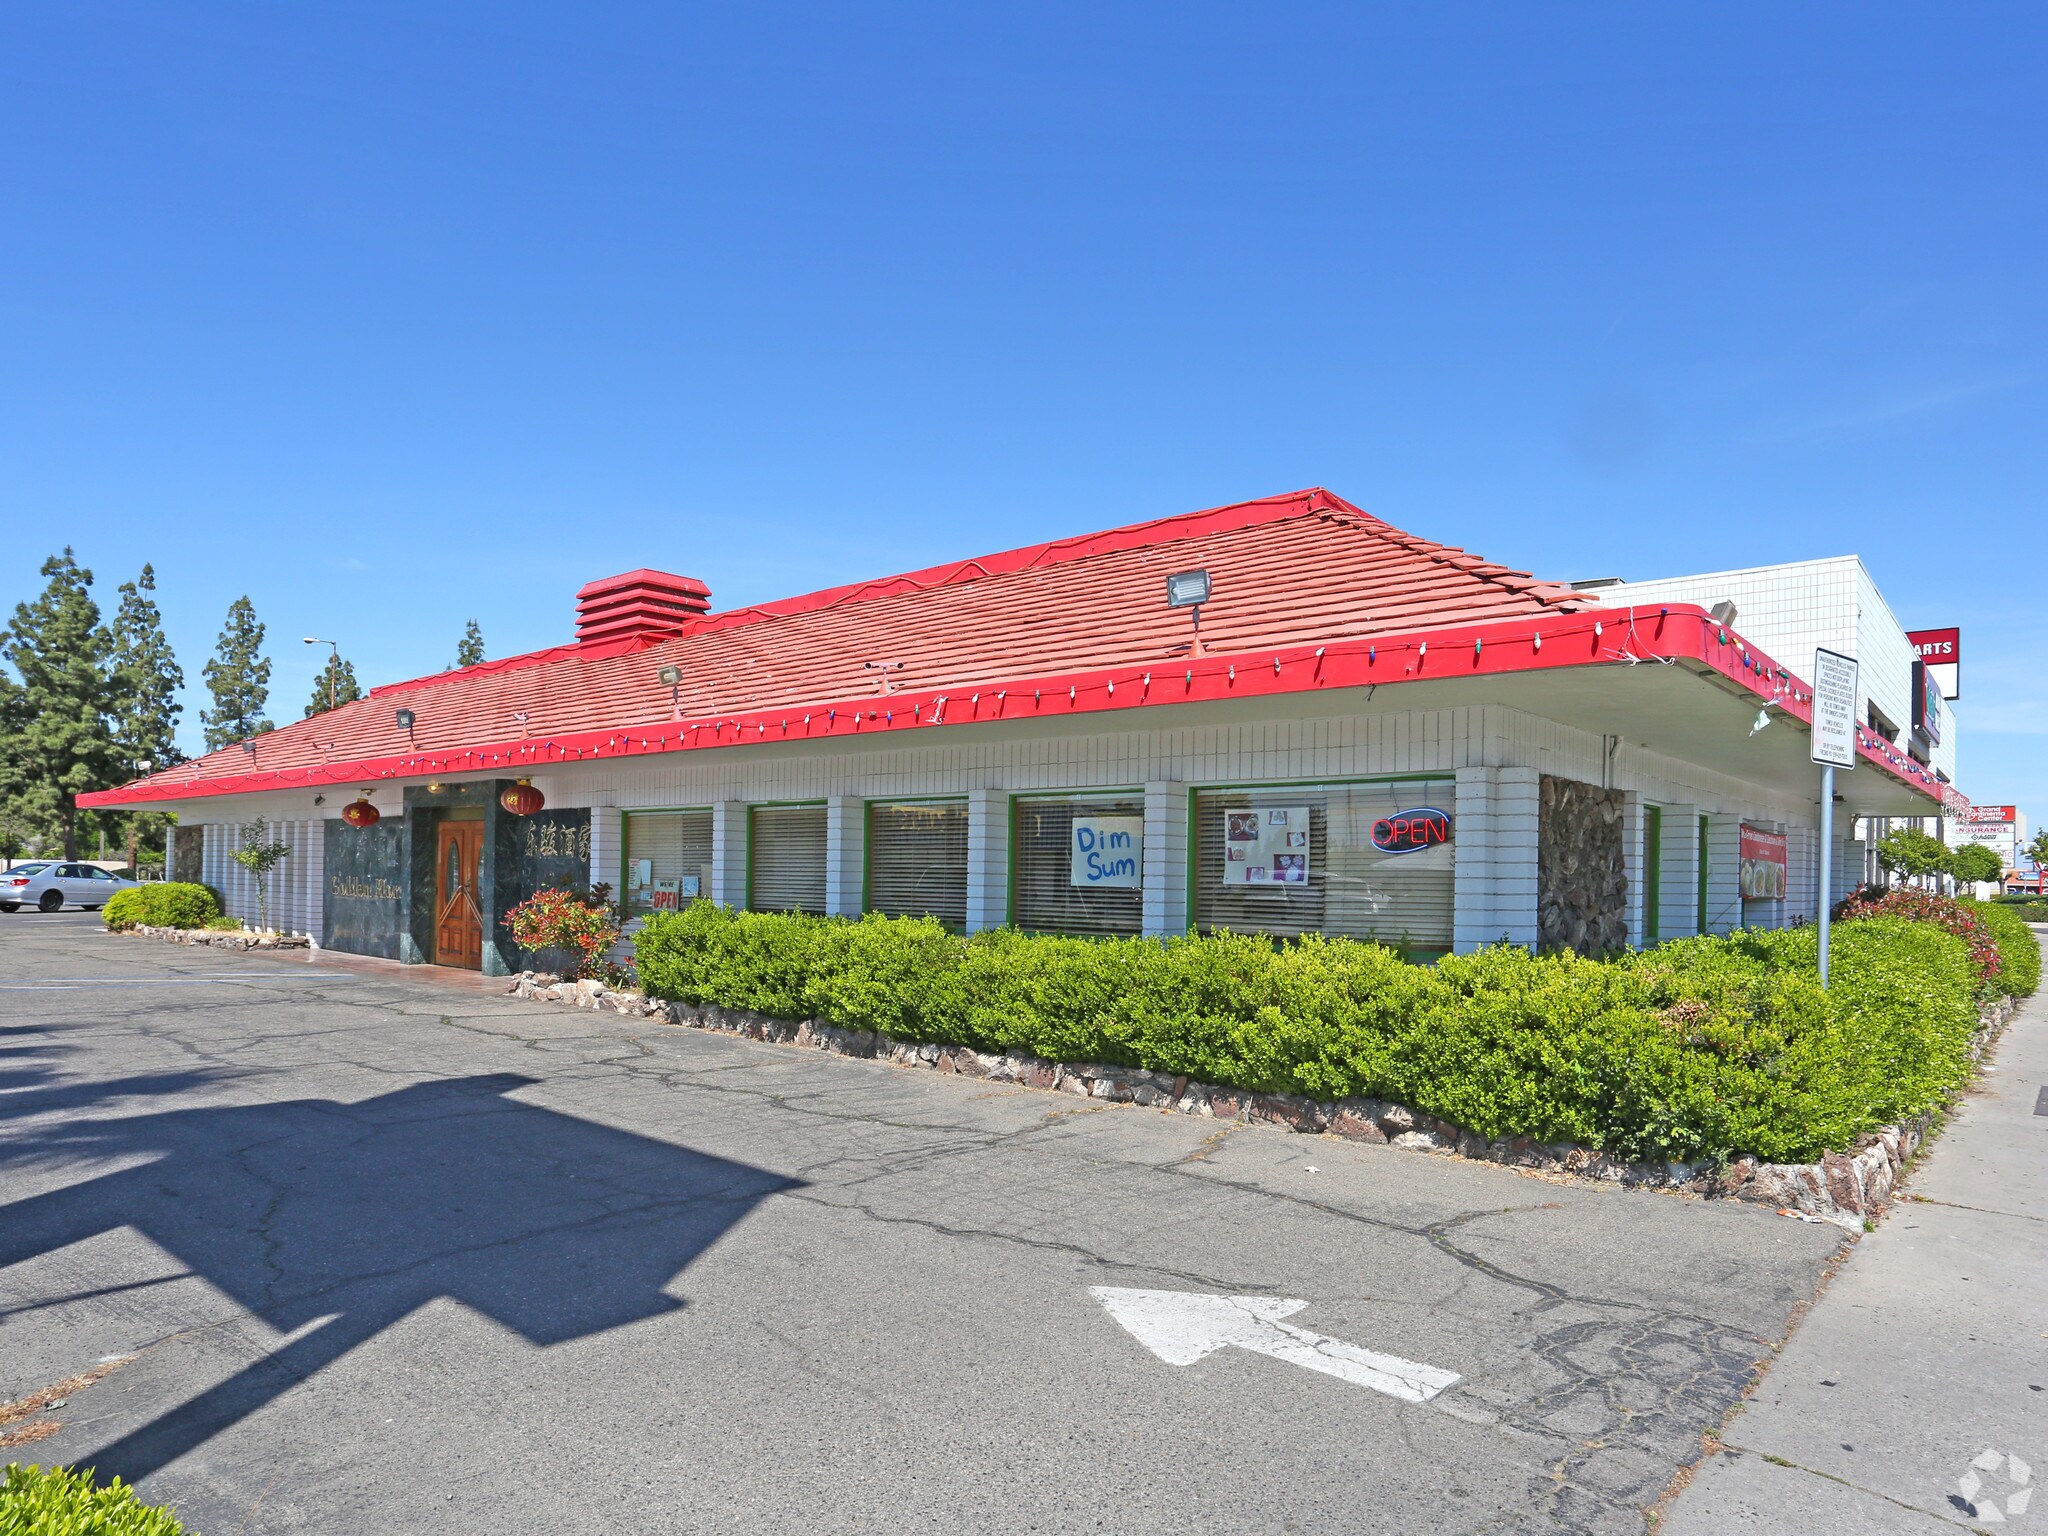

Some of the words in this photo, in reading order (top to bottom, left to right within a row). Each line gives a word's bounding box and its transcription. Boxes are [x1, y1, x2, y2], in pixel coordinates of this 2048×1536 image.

[1077, 827, 1131, 852] Dim
[1370, 818, 1446, 844] OPEN
[1087, 852, 1136, 881] Sum
[330, 875, 372, 898] Golden
[653, 891, 679, 910] OPEN
